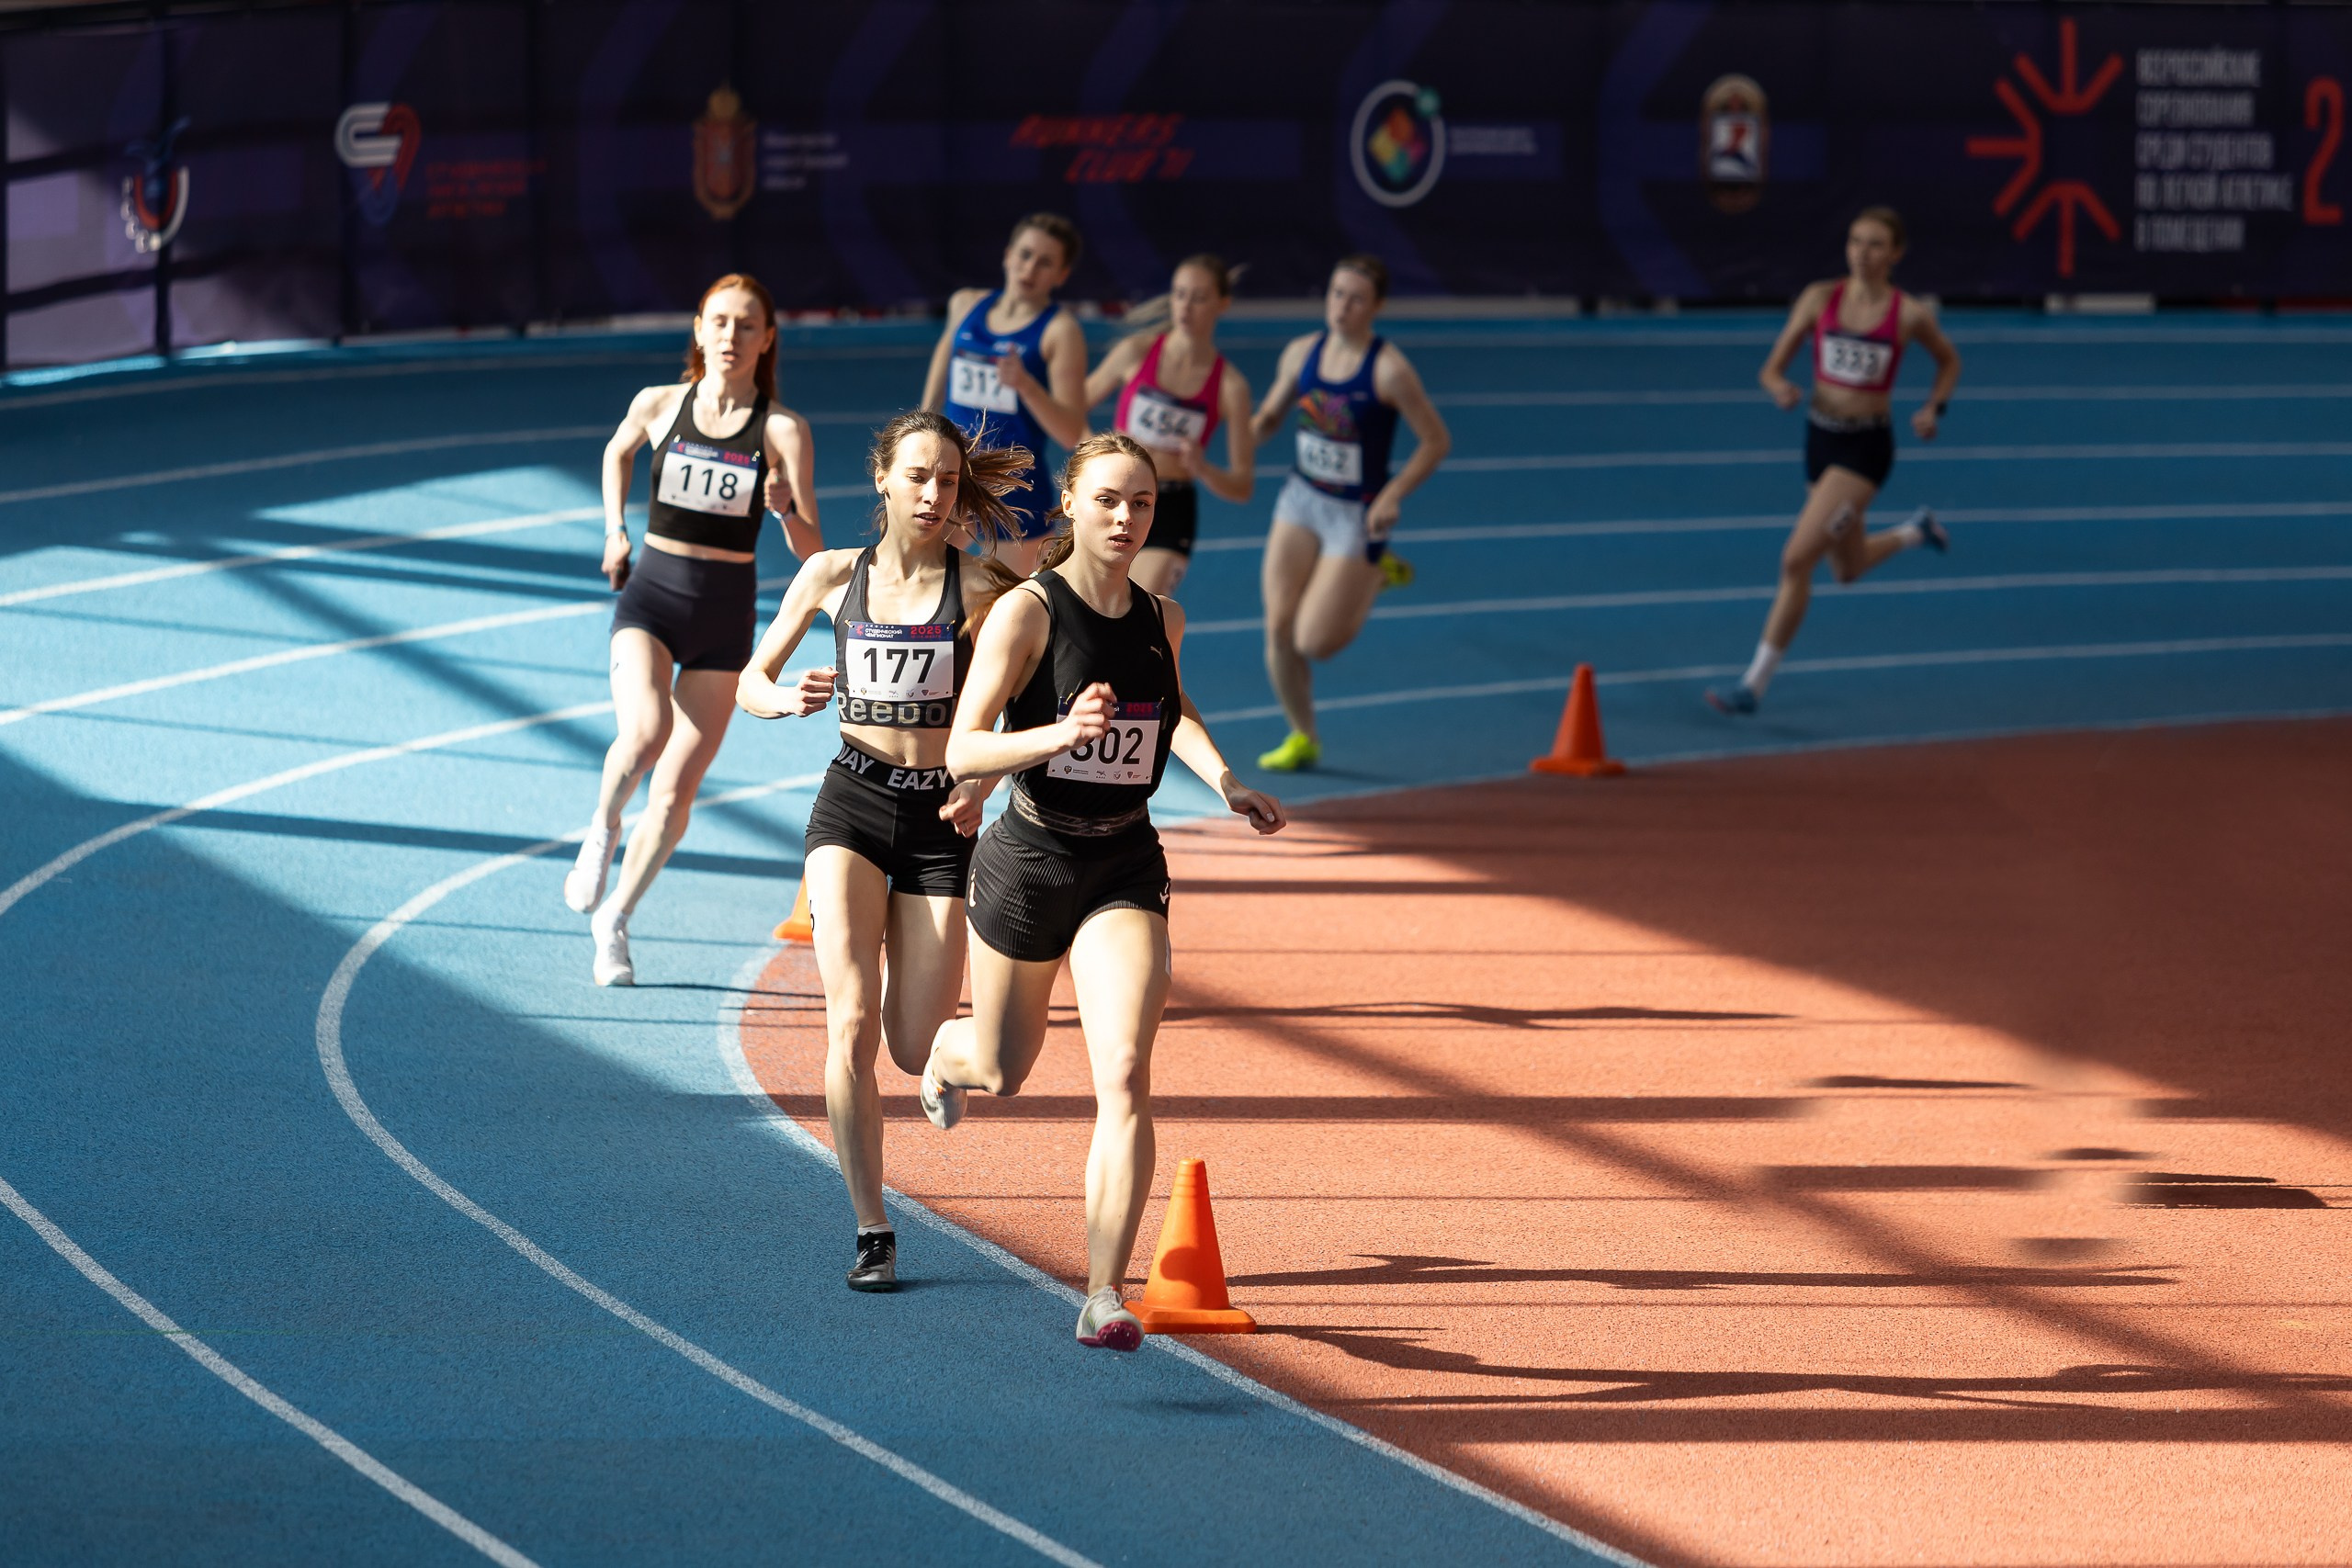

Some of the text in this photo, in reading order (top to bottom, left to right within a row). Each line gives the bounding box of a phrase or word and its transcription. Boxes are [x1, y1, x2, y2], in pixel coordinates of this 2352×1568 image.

[1139, 406, 1189, 436] 454
[681, 464, 738, 501] 118
[910, 626, 941, 634] 2025
[864, 648, 935, 683] 177
[888, 768, 949, 790] EAZY
